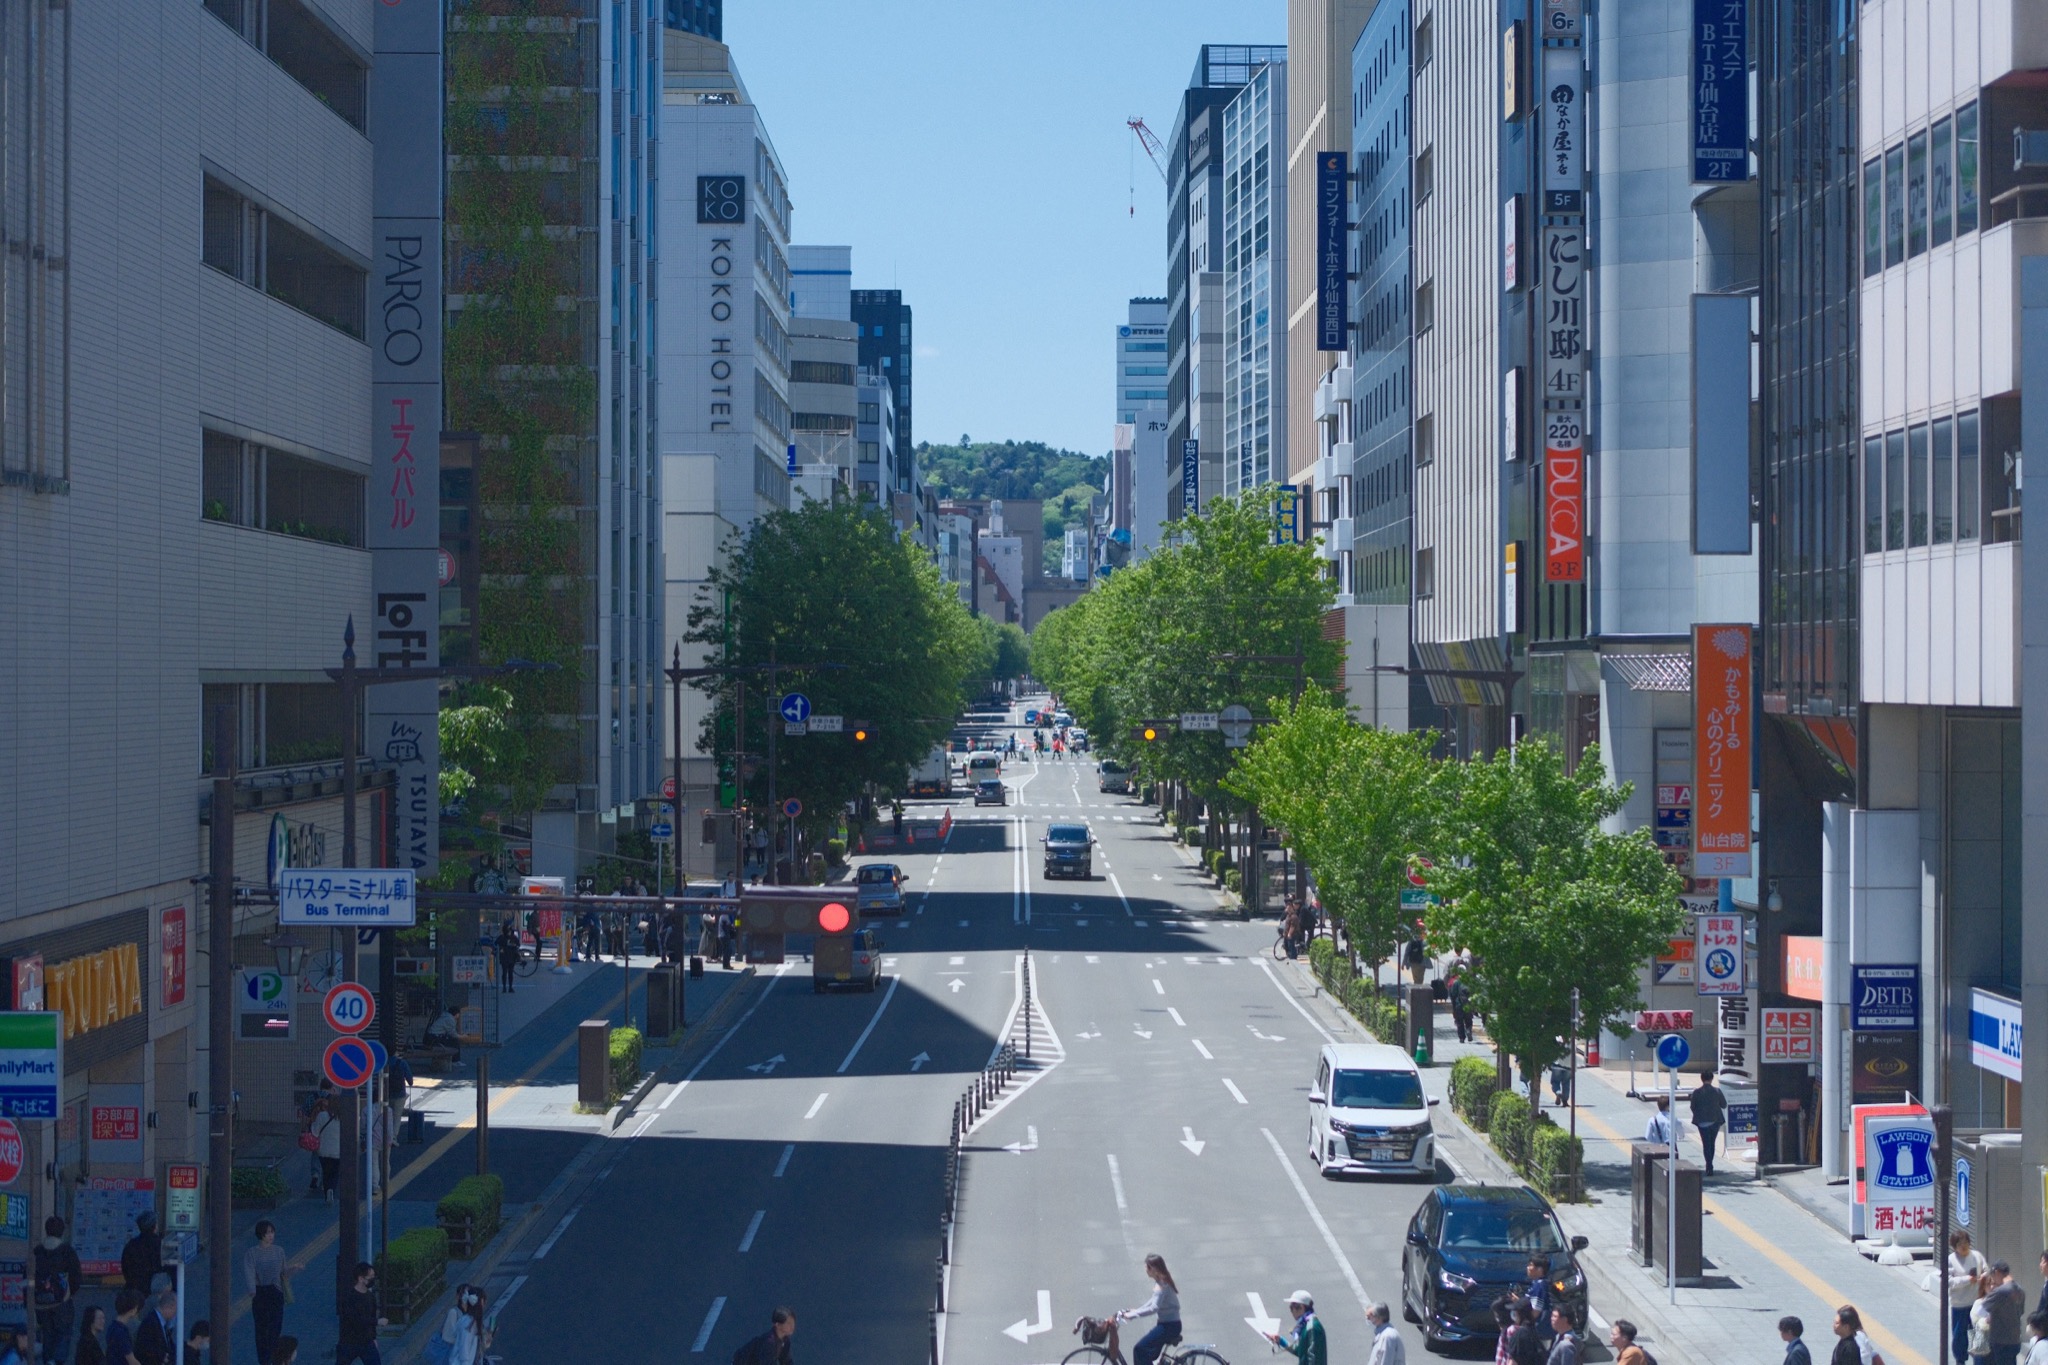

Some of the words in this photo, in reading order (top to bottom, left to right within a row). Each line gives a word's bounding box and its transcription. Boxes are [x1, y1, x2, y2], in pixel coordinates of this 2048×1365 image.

[1551, 11, 1574, 30] 6F
[1698, 23, 1719, 144] BTB仙台店
[1708, 161, 1731, 179] 2F
[704, 180, 739, 198] KO
[1554, 193, 1571, 206] 5F
[704, 201, 739, 219] KO
[1325, 180, 1339, 345] コンフォートホテル仙台西口
[711, 239, 731, 323] KOKO
[384, 235, 423, 366] PARCO
[1549, 234, 1580, 361] にし川邸
[711, 338, 731, 432] HOTEL
[1548, 367, 1580, 391] 4F
[1549, 424, 1580, 439] 220
[1556, 440, 1572, 448] 名様
[390, 398, 417, 530] エスパル
[1549, 458, 1579, 557] DUCCA
[1724, 666, 1743, 749] かもみーる
[1706, 707, 1724, 819] 心のクリニック
[410, 774, 427, 869] TSUTAYA
[1701, 832, 1745, 849] 仙台院
[1713, 856, 1735, 871] 3F
[287, 877, 408, 901] バスターミナル前
[586, 878, 594, 887] P
[306, 903, 329, 916] Bus
[335, 903, 390, 916] Terminal
[1707, 918, 1734, 931] 買取
[1703, 934, 1737, 946] トレカ
[45, 942, 143, 1041] TSUTAYA
[1700, 982, 1740, 992] シーガル
[267, 1000, 288, 1010] 24h
[335, 997, 364, 1020] 40
[1637, 1011, 1694, 1031] JAM
[11, 1100, 50, 1114] たばこ
[96, 1107, 136, 1121] お部屋
[1879, 1132, 1929, 1145] LAWSON
[1881, 1173, 1929, 1186] STATION
